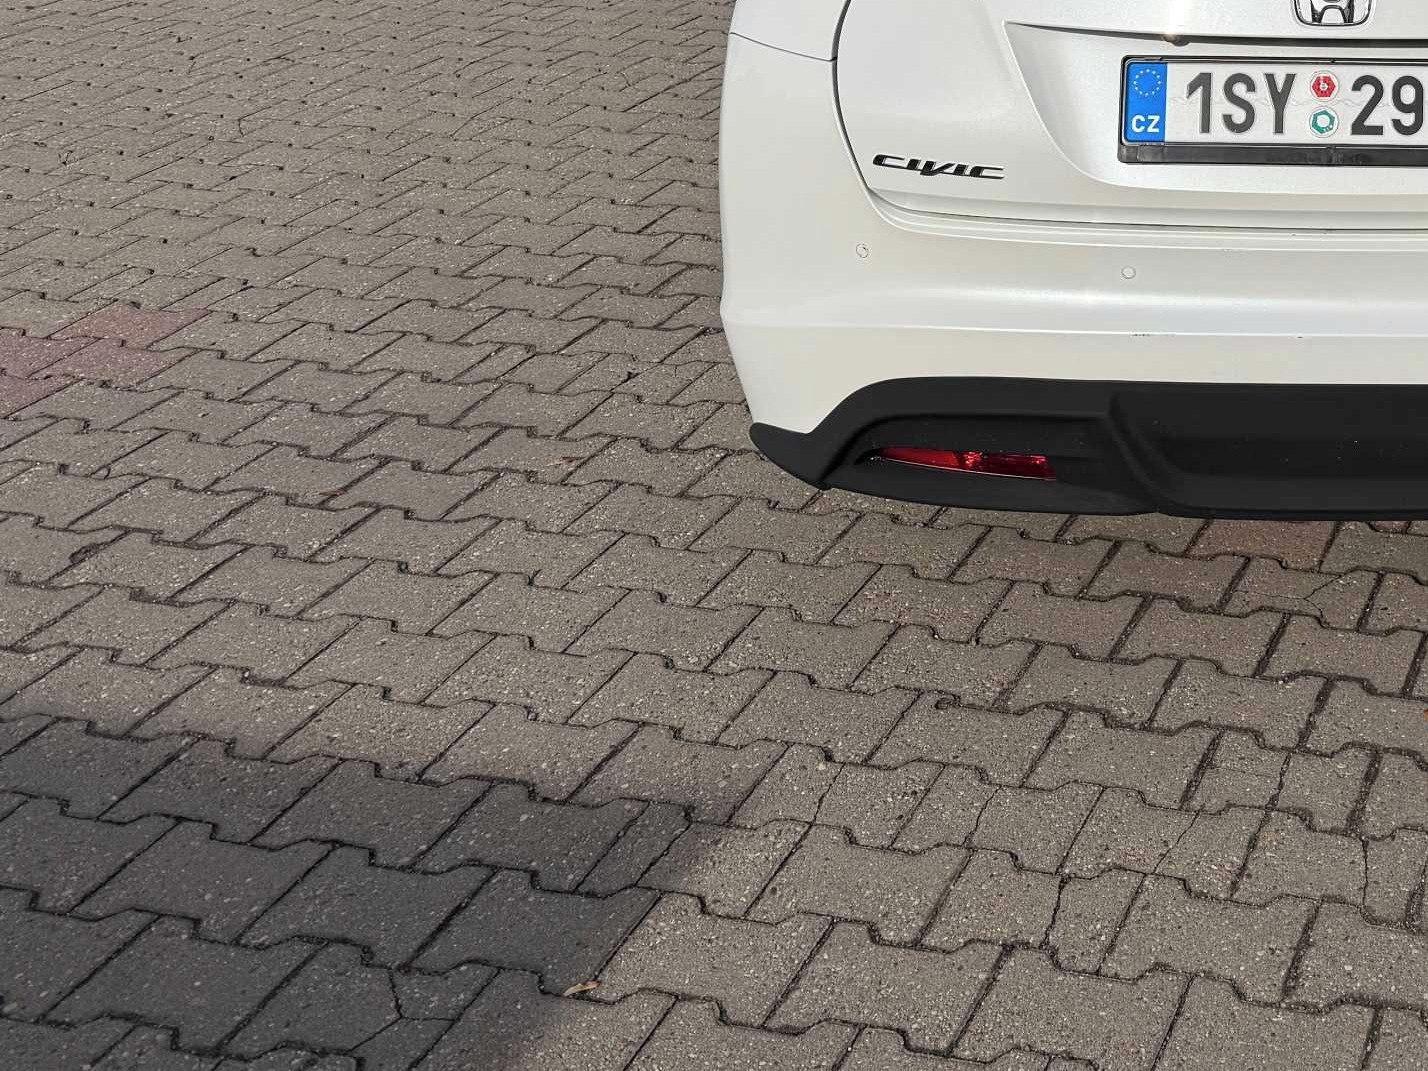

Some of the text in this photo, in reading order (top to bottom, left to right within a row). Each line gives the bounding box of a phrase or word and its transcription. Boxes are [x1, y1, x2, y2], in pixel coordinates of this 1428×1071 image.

[1131, 115, 1160, 133] CZ
[1185, 72, 1297, 135] 1SY
[872, 153, 1005, 180] CIVIC
